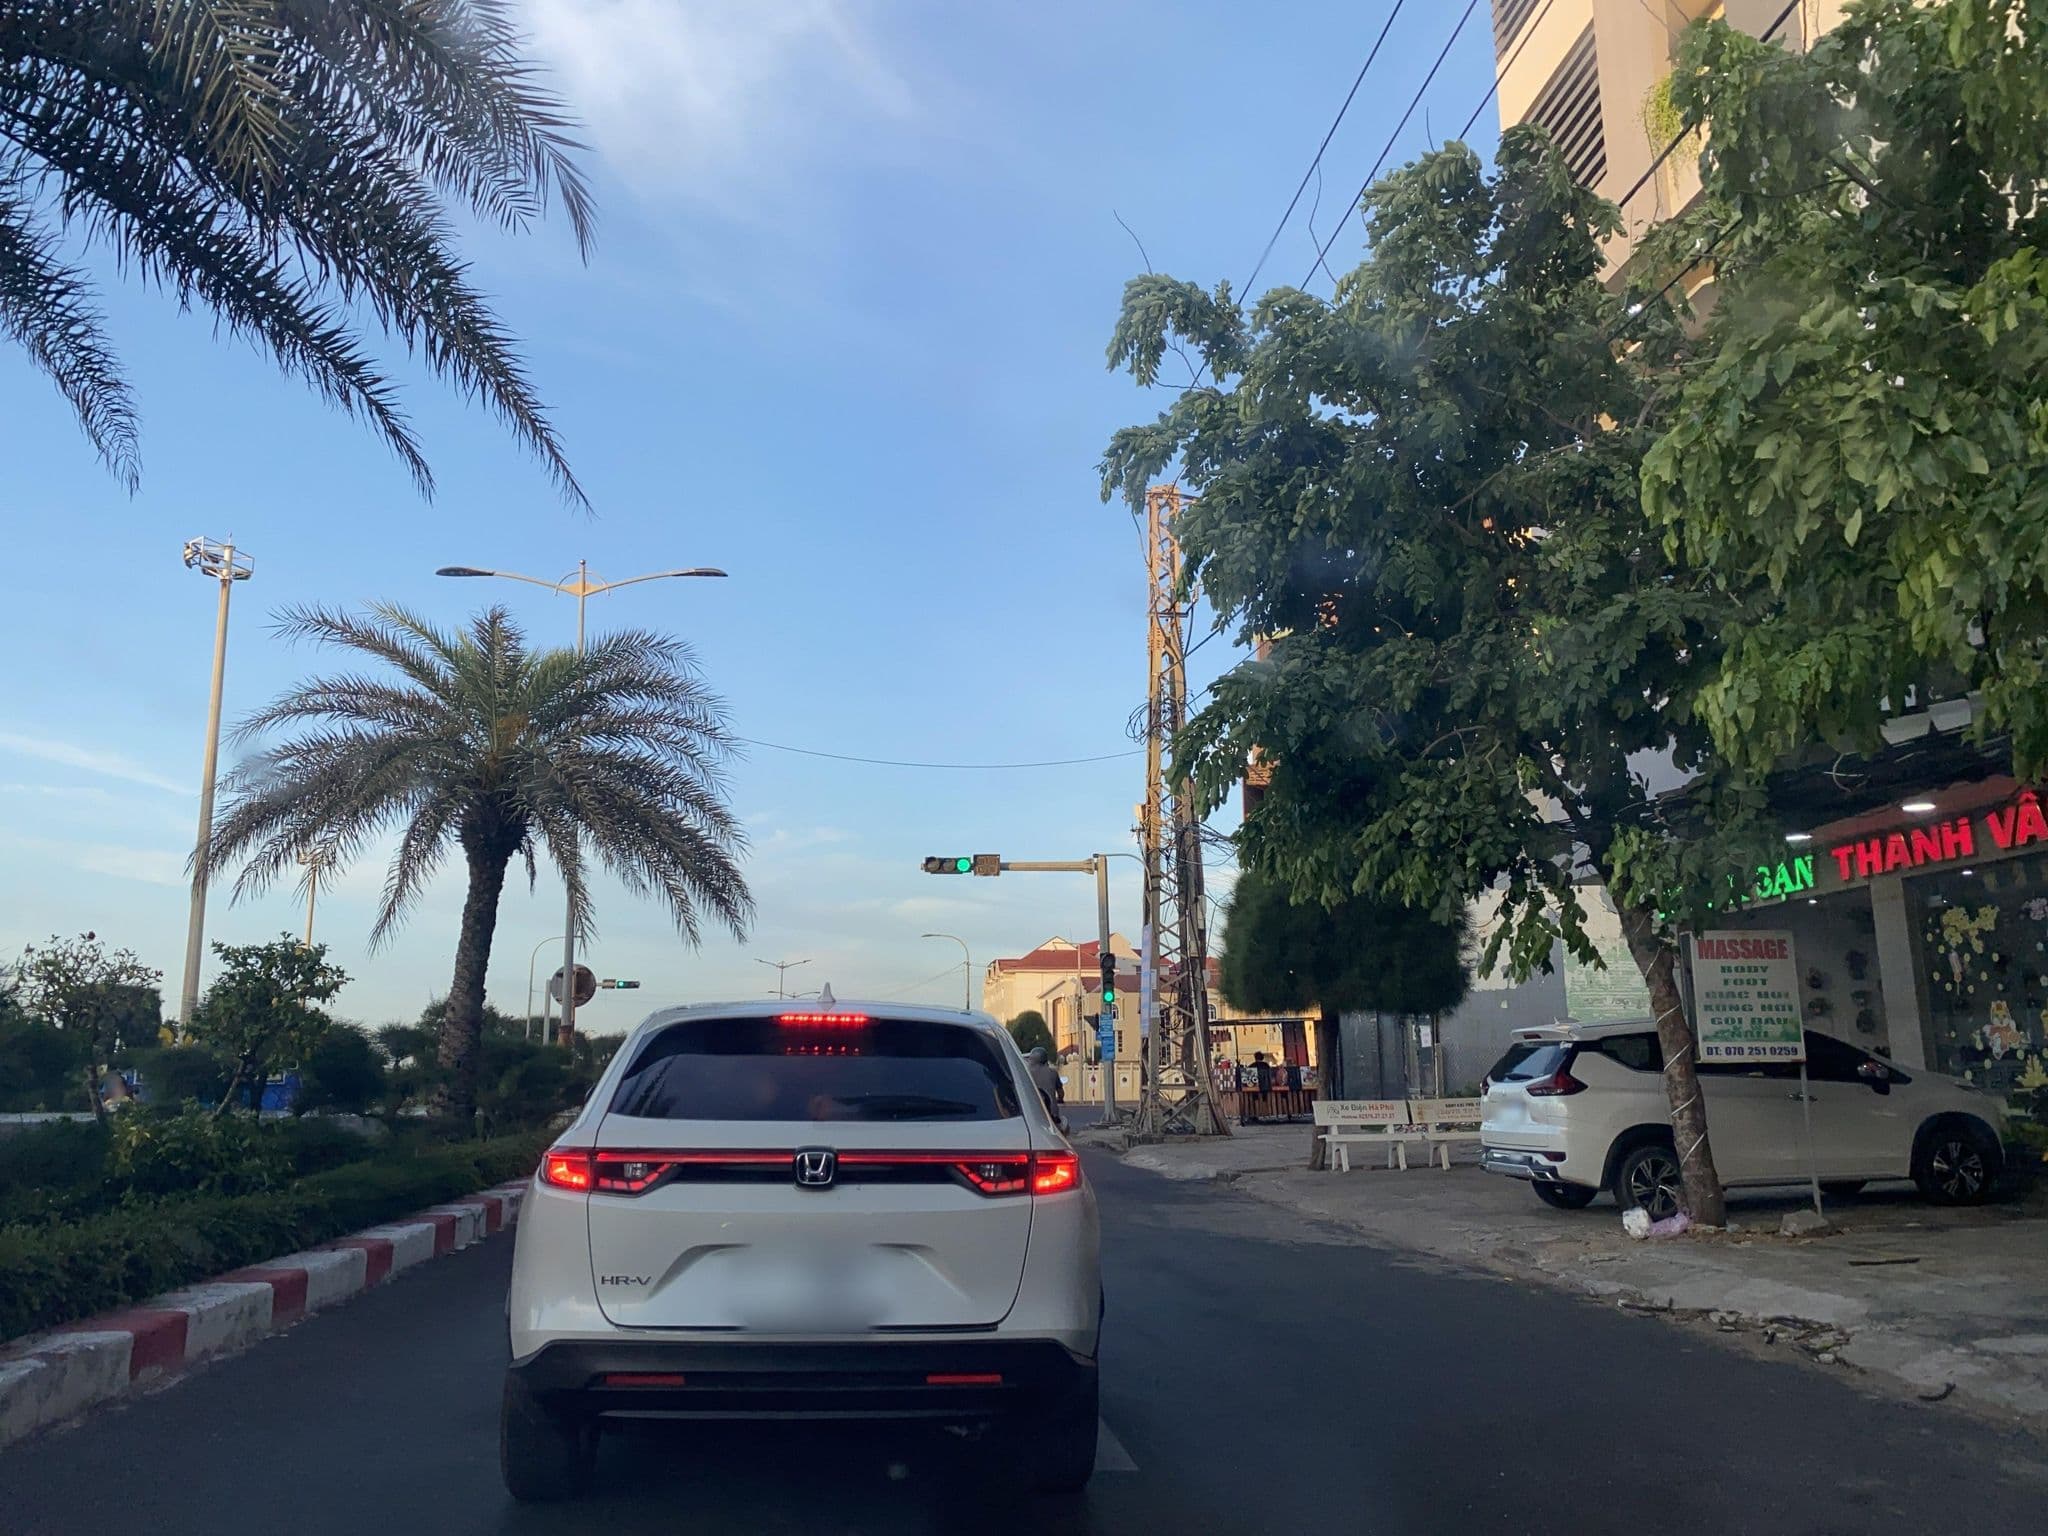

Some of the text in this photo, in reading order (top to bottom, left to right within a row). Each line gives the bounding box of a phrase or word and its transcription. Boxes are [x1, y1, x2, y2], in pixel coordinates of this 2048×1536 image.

[1831, 817, 1974, 881] THANH
[1985, 790, 2048, 849] VÂ
[1697, 939, 1788, 960] MASSAGE
[1720, 965, 1768, 973] BODY
[1723, 978, 1768, 986] FOOT
[1725, 1046, 1744, 1056] 070
[1748, 1046, 1766, 1056] 251
[1770, 1046, 1798, 1056] 0259
[601, 1275, 651, 1286] HR-V
